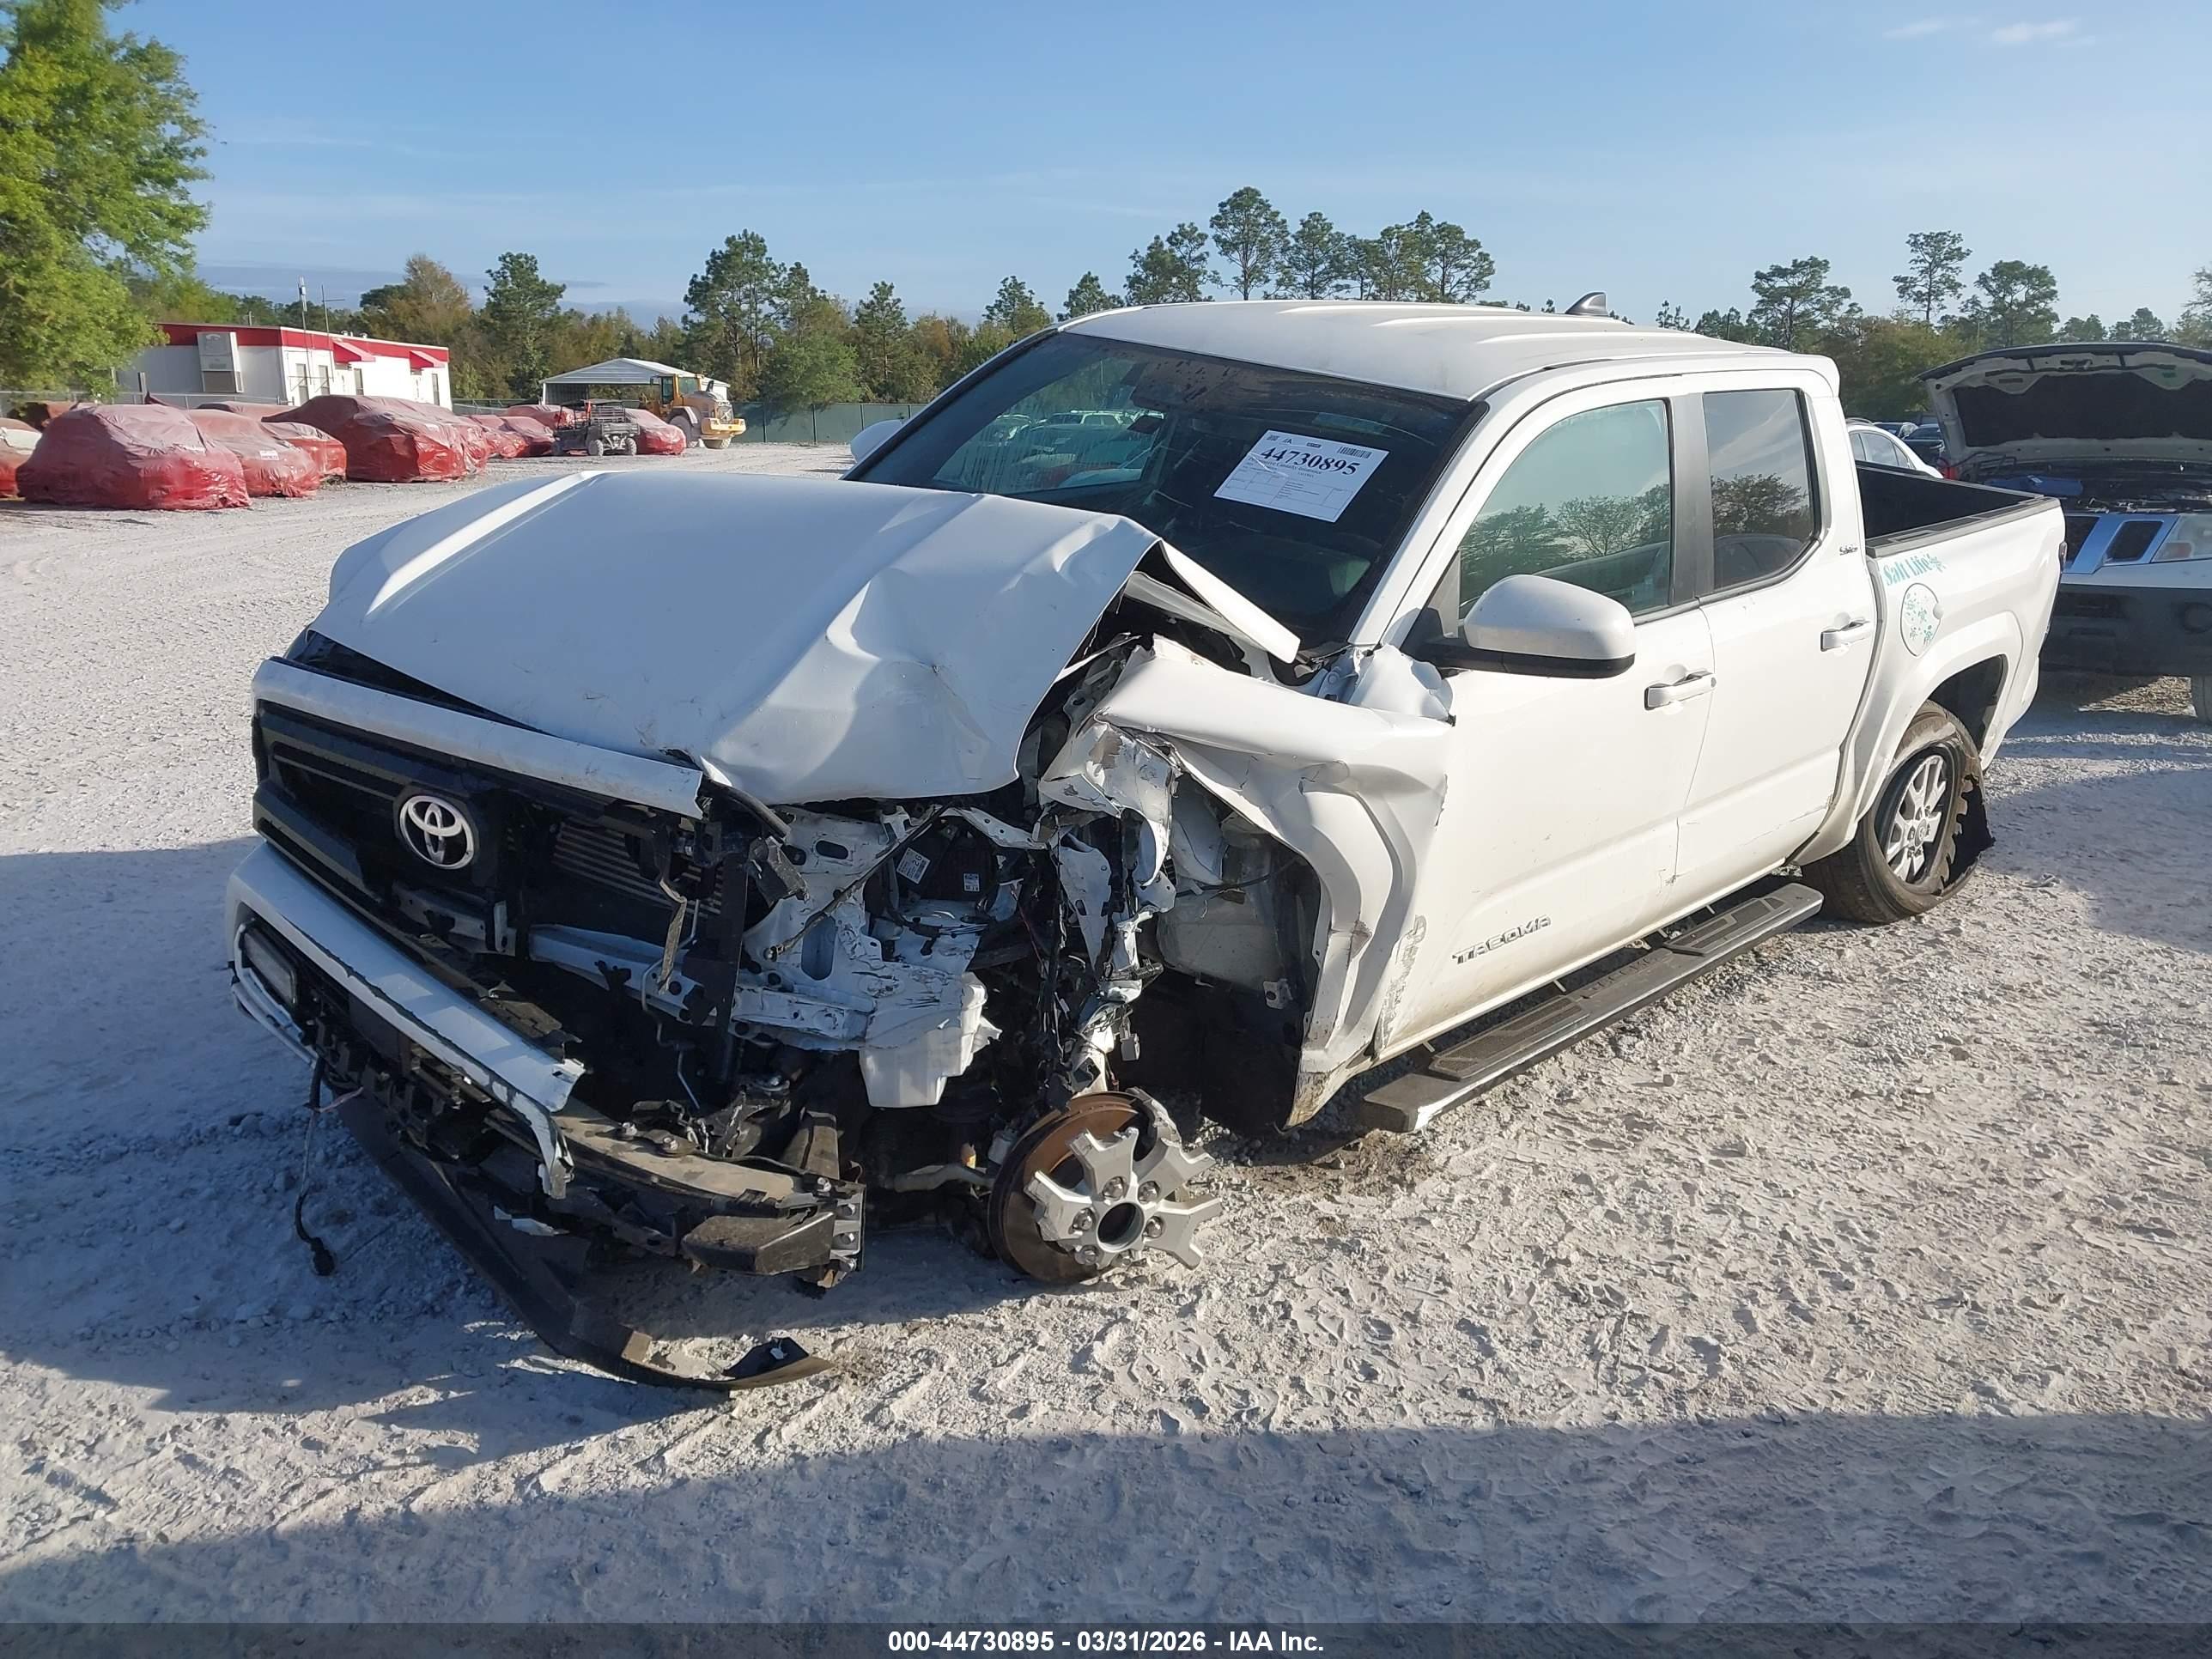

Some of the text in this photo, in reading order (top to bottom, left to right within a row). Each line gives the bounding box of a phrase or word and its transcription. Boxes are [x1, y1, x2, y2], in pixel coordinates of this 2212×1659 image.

[1261, 447, 1360, 475] 44730895
[1883, 562, 1910, 586] Salt
[1453, 915, 1551, 963] TACOMA
